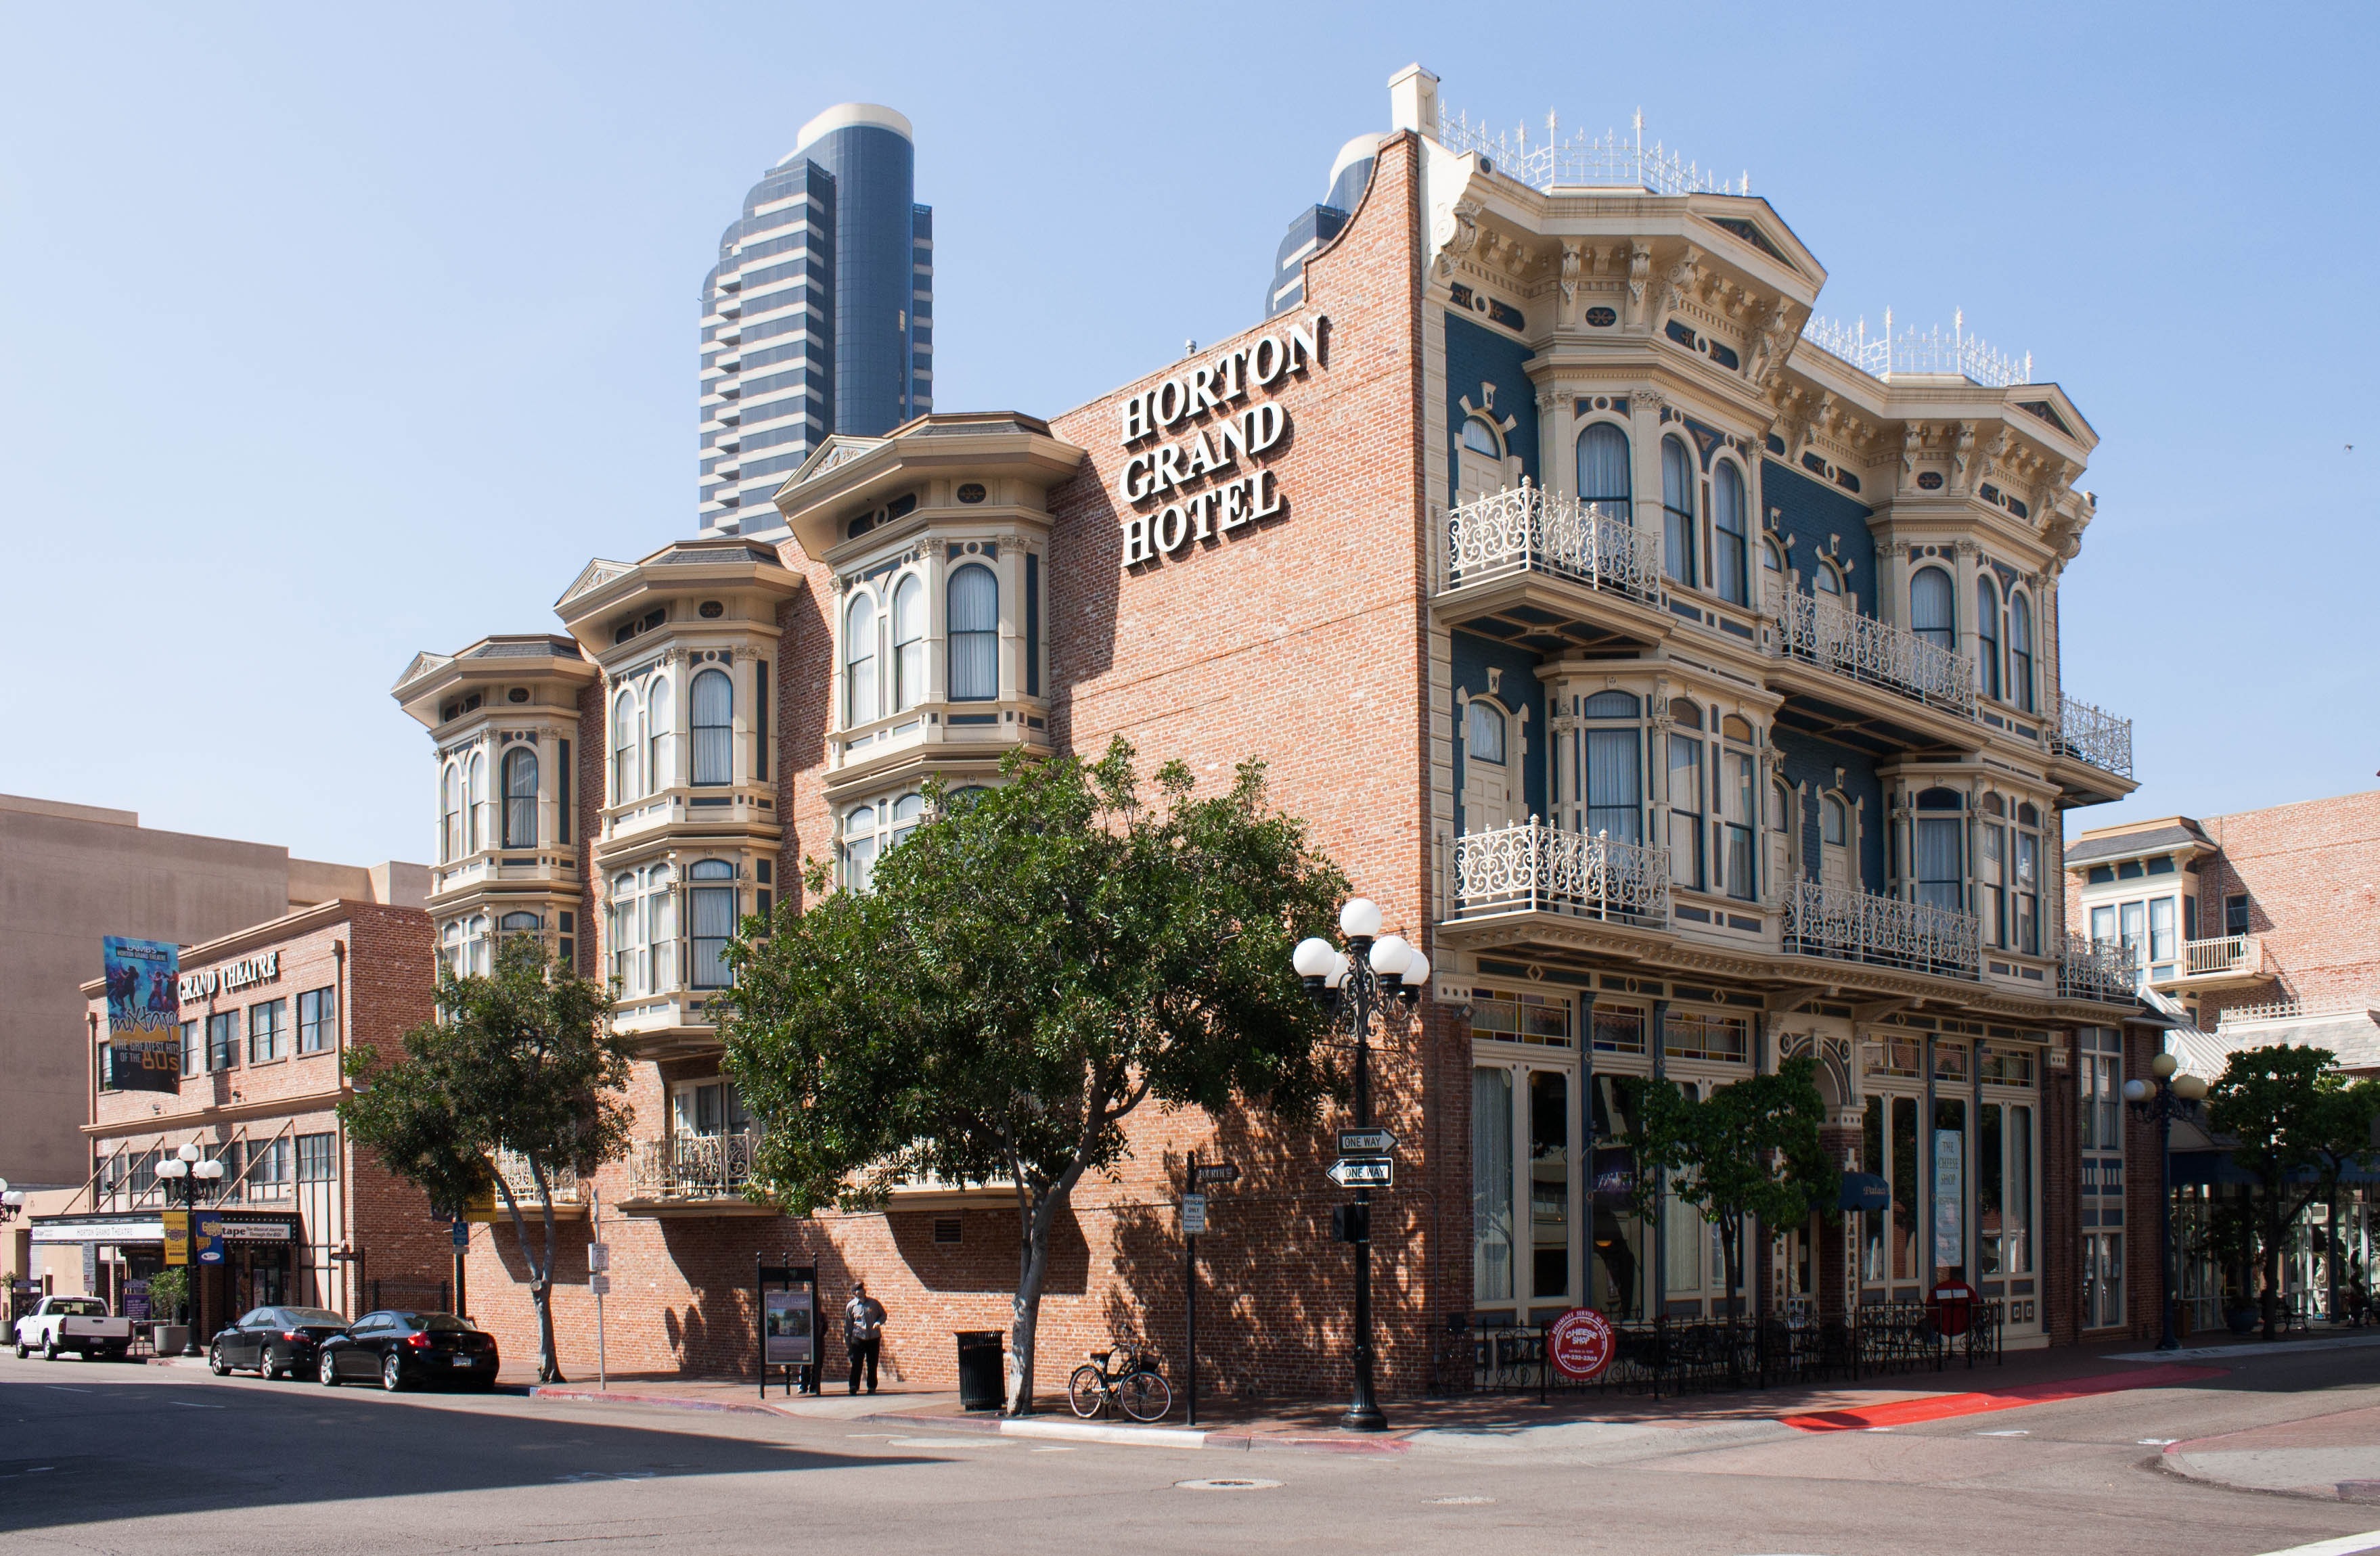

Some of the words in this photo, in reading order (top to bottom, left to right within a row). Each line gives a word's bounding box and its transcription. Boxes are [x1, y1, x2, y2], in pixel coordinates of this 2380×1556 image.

[1121, 314, 1324, 447] HORTON
[1119, 401, 1284, 503] GRAND
[1120, 470, 1280, 568] HOTEL
[178, 971, 216, 1001] GRAND
[221, 951, 276, 988] THEATRE
[114, 1038, 129, 1051] THE
[130, 1039, 164, 1053] GREATEST
[165, 1043, 179, 1055] HITS
[120, 1052, 128, 1062] OF
[129, 1053, 141, 1063] THE
[141, 1050, 179, 1071] 80s
[1345, 1137, 1362, 1147] ONE
[1364, 1136, 1380, 1147] WAY
[1942, 1141, 1954, 1153] THE
[1937, 1158, 1959, 1170] CHEESE
[1198, 1168, 1224, 1179] FOURTH
[1345, 1168, 1363, 1178] ONE
[1366, 1166, 1385, 1177] WAY
[1940, 1174, 1956, 1185] SHOP
[112, 1227, 133, 1236] THEATRE
[222, 1227, 246, 1237] tape
[1596, 1316, 1604, 1325] ALL
[1565, 1328, 1598, 1340] CHEESE
[1572, 1336, 1590, 1345] SHOP
